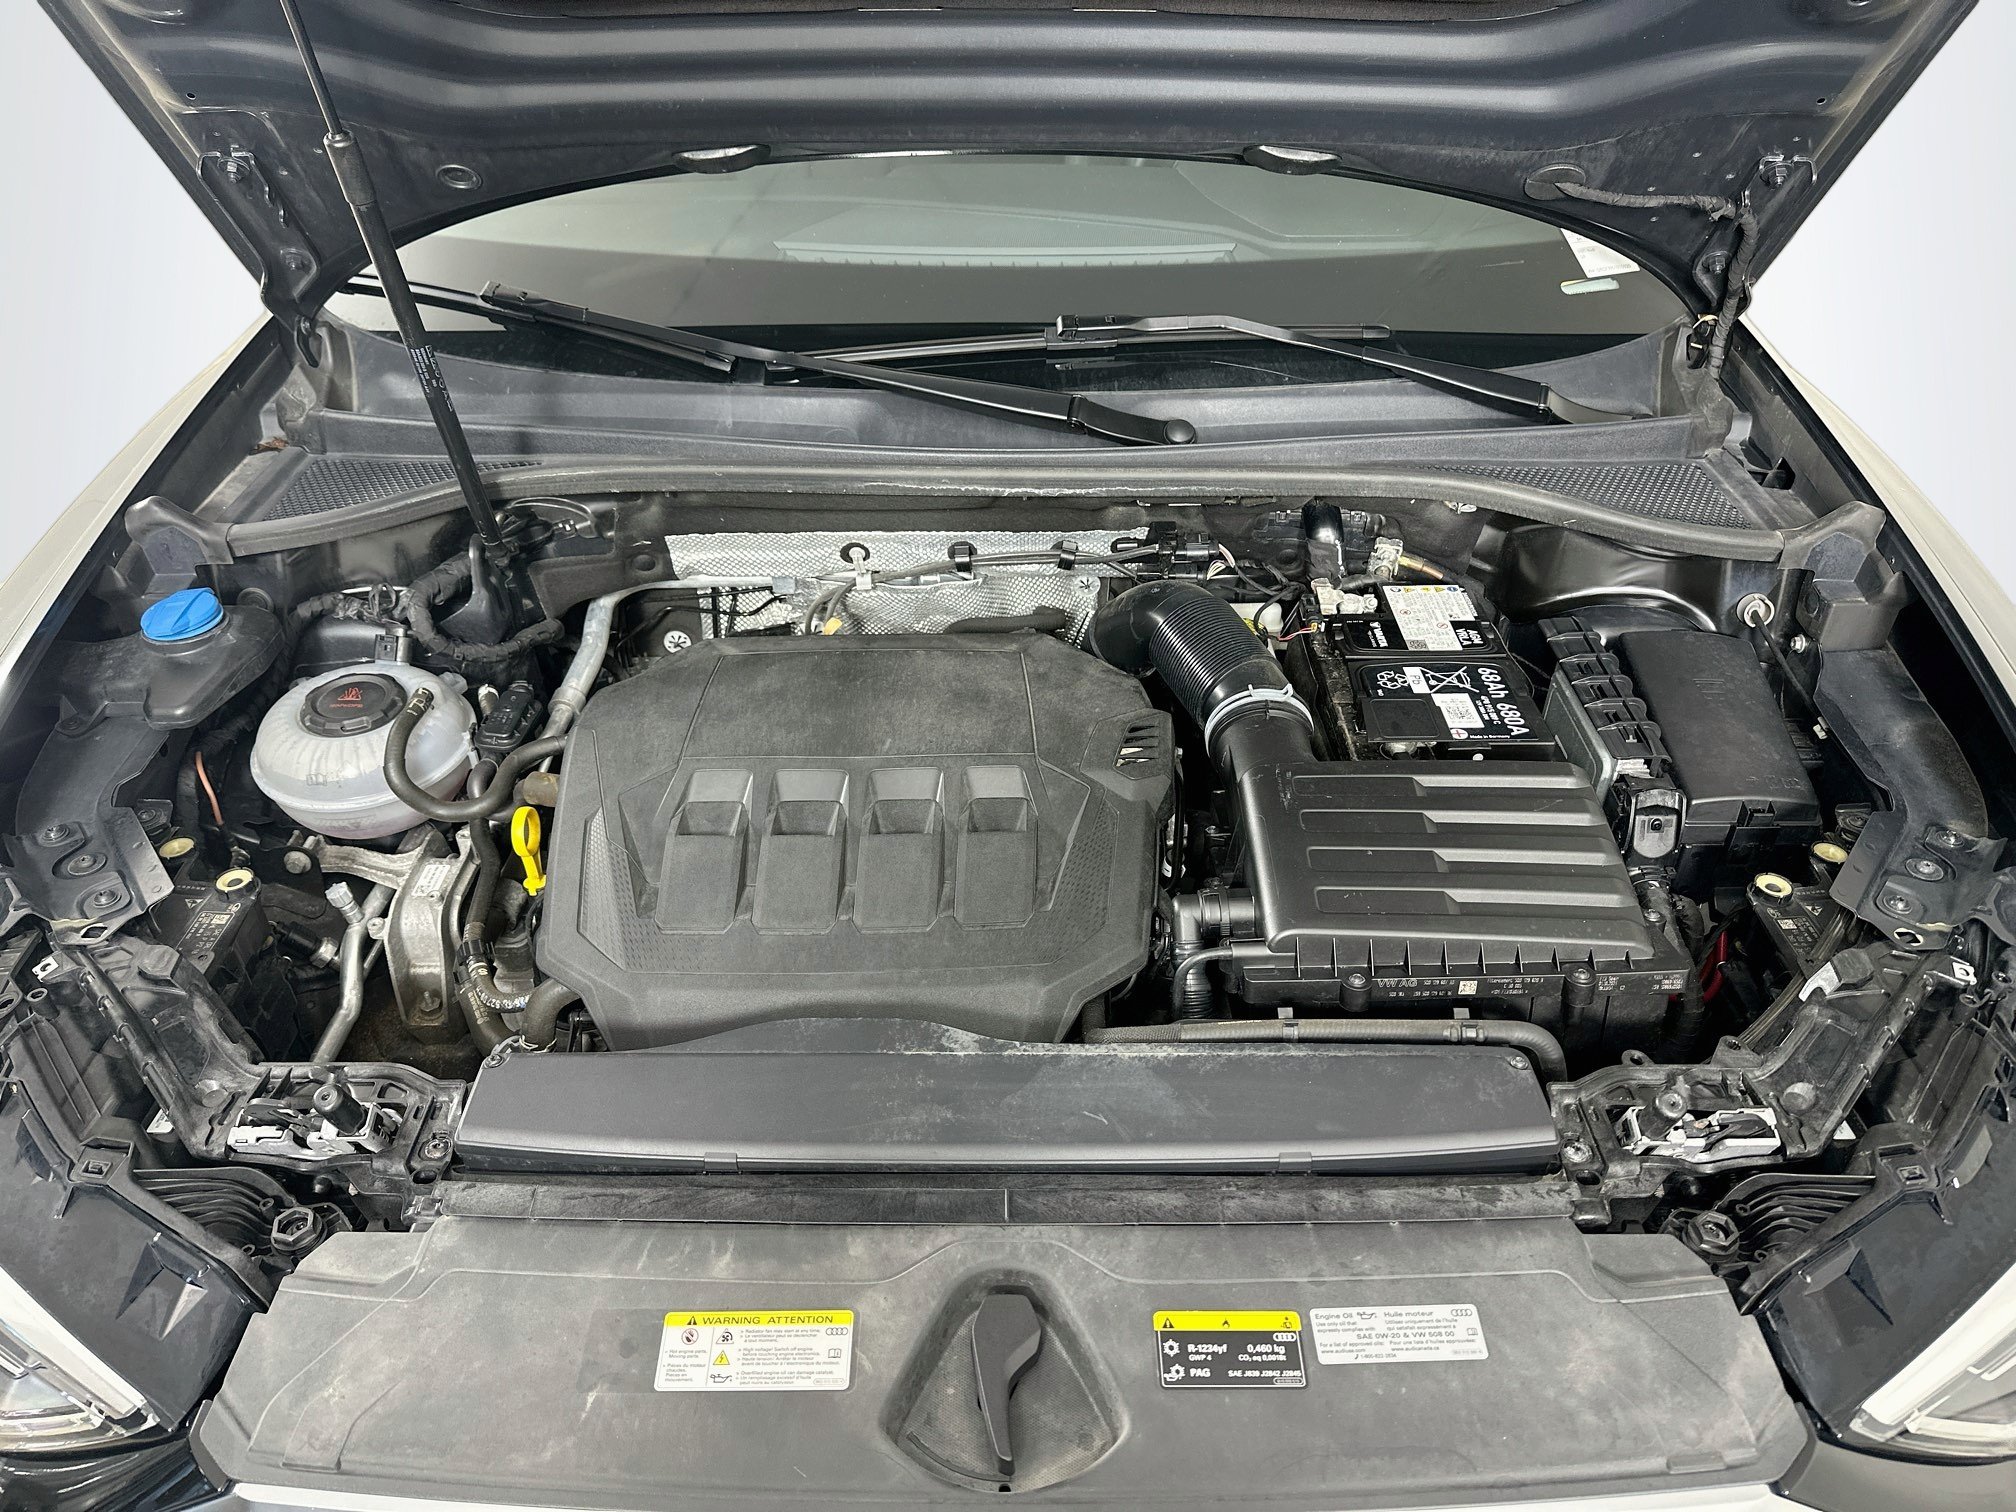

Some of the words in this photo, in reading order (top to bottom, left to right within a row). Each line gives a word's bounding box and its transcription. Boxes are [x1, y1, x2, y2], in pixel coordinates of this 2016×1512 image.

[1456, 628, 1472, 645] VRLA
[1467, 630, 1483, 644] AGM
[1410, 675, 1420, 684] Pb
[1478, 668, 1509, 698] 68Ah
[1496, 703, 1530, 735] 680A
[1378, 979, 1397, 987] VW
[1399, 979, 1417, 987] AG
[702, 1316, 760, 1325] WARNING
[767, 1316, 833, 1324] ATTENTION
[1187, 1344, 1228, 1354] R-1234yf
[1247, 1344, 1272, 1354] 0,460
[1274, 1344, 1285, 1354] kg
[1190, 1368, 1211, 1377] PAG
